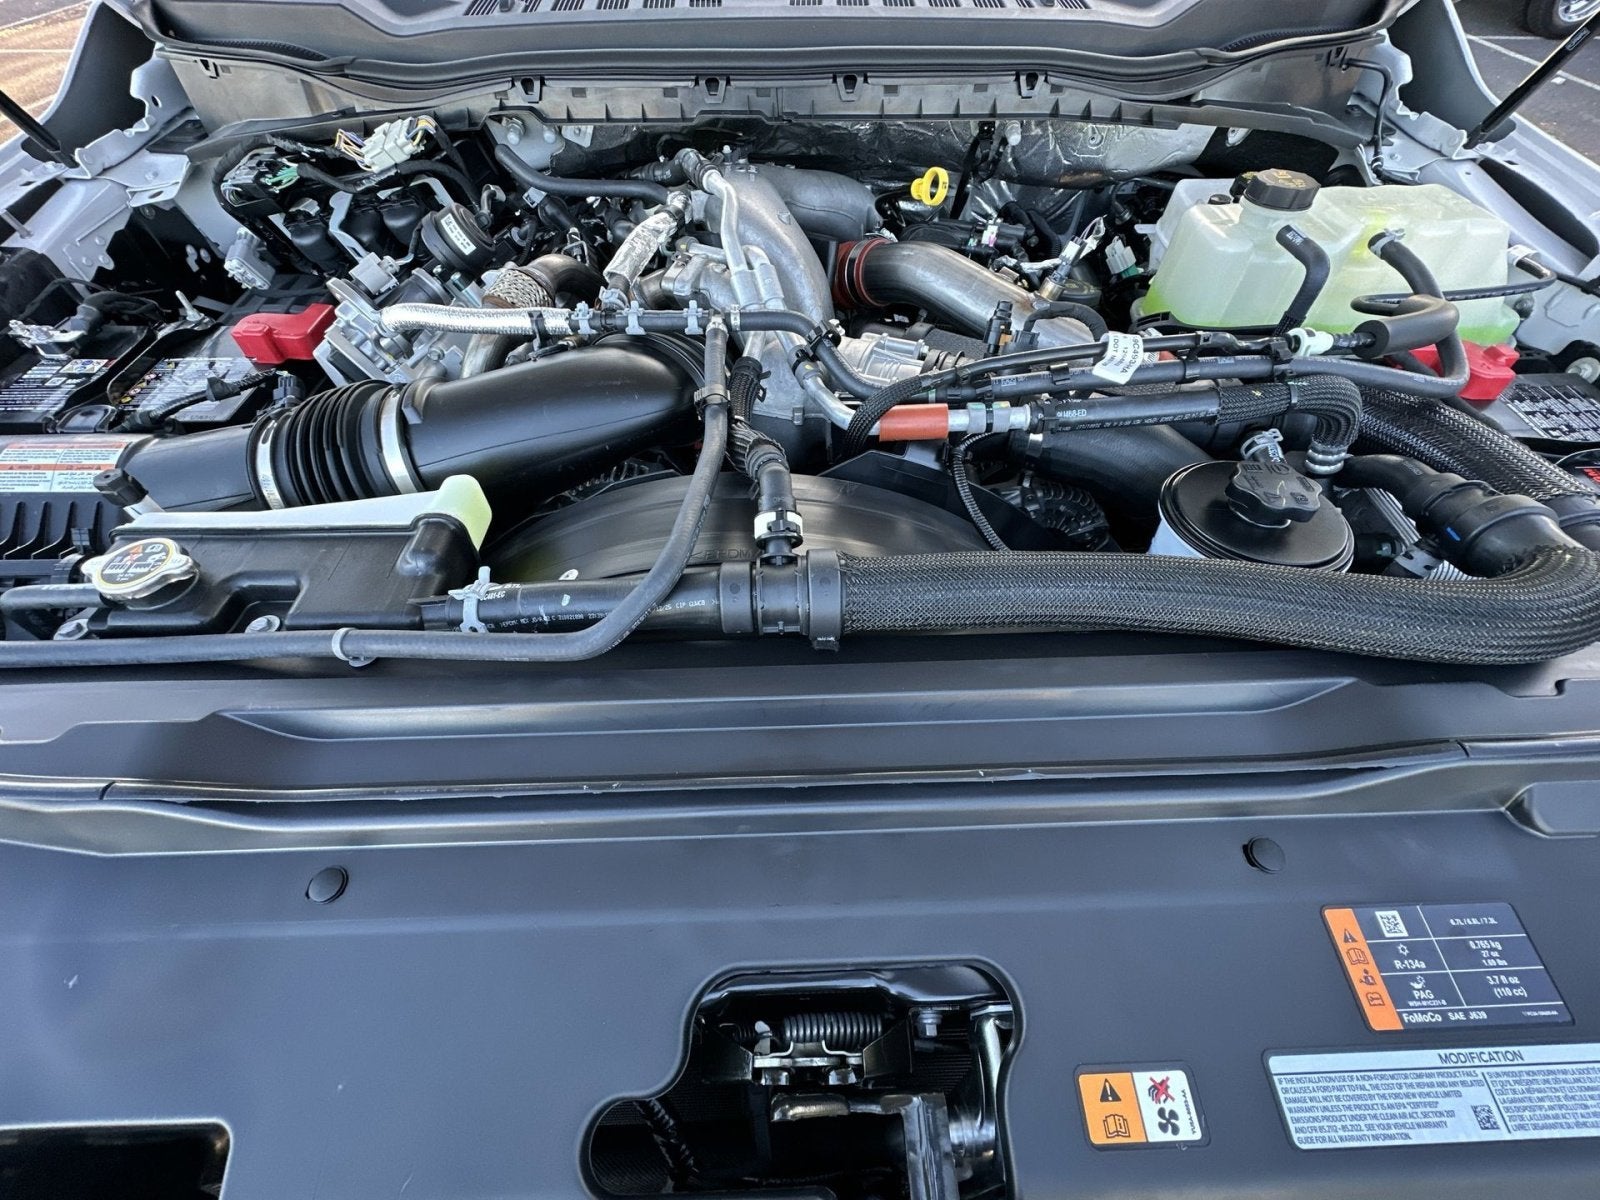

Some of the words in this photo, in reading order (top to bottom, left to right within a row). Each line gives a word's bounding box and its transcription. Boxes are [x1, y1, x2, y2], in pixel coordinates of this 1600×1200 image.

[1468, 940, 1490, 949] 0.765
[1490, 940, 1502, 950] kg
[1394, 959, 1426, 970] R-134a
[1486, 976, 1499, 984] 3.7
[1412, 990, 1434, 1000] PAG
[1494, 987, 1512, 998] (110
[1513, 986, 1527, 998] cc)
[1402, 1012, 1442, 1023] FoMoCo
[1448, 1012, 1466, 1020] SAE
[1469, 1011, 1488, 1019] J639
[1438, 1050, 1524, 1064] MODIFICATION
